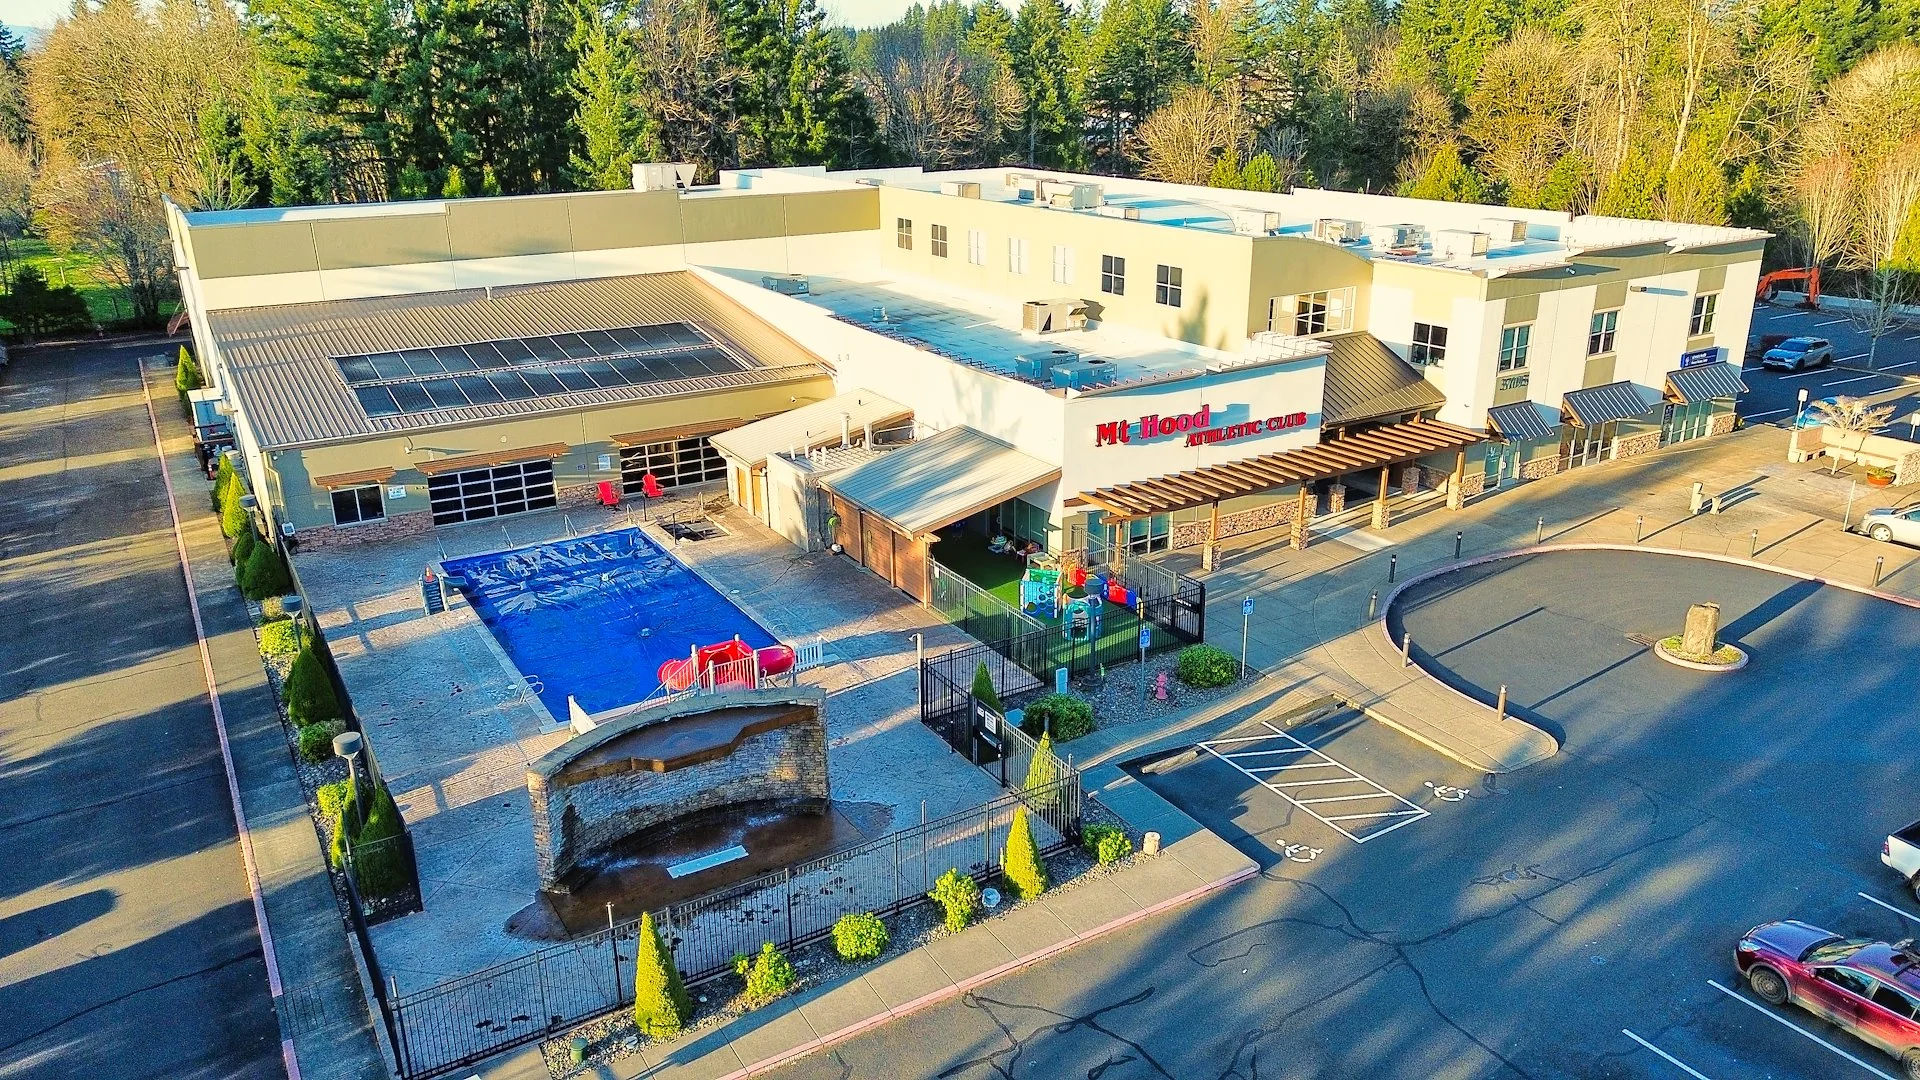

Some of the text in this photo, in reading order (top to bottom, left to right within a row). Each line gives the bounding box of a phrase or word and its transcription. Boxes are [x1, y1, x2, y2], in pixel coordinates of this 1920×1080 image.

[1095, 403, 1210, 448] Mt Hood
[1184, 412, 1308, 448] ATHLETIC CLUB
